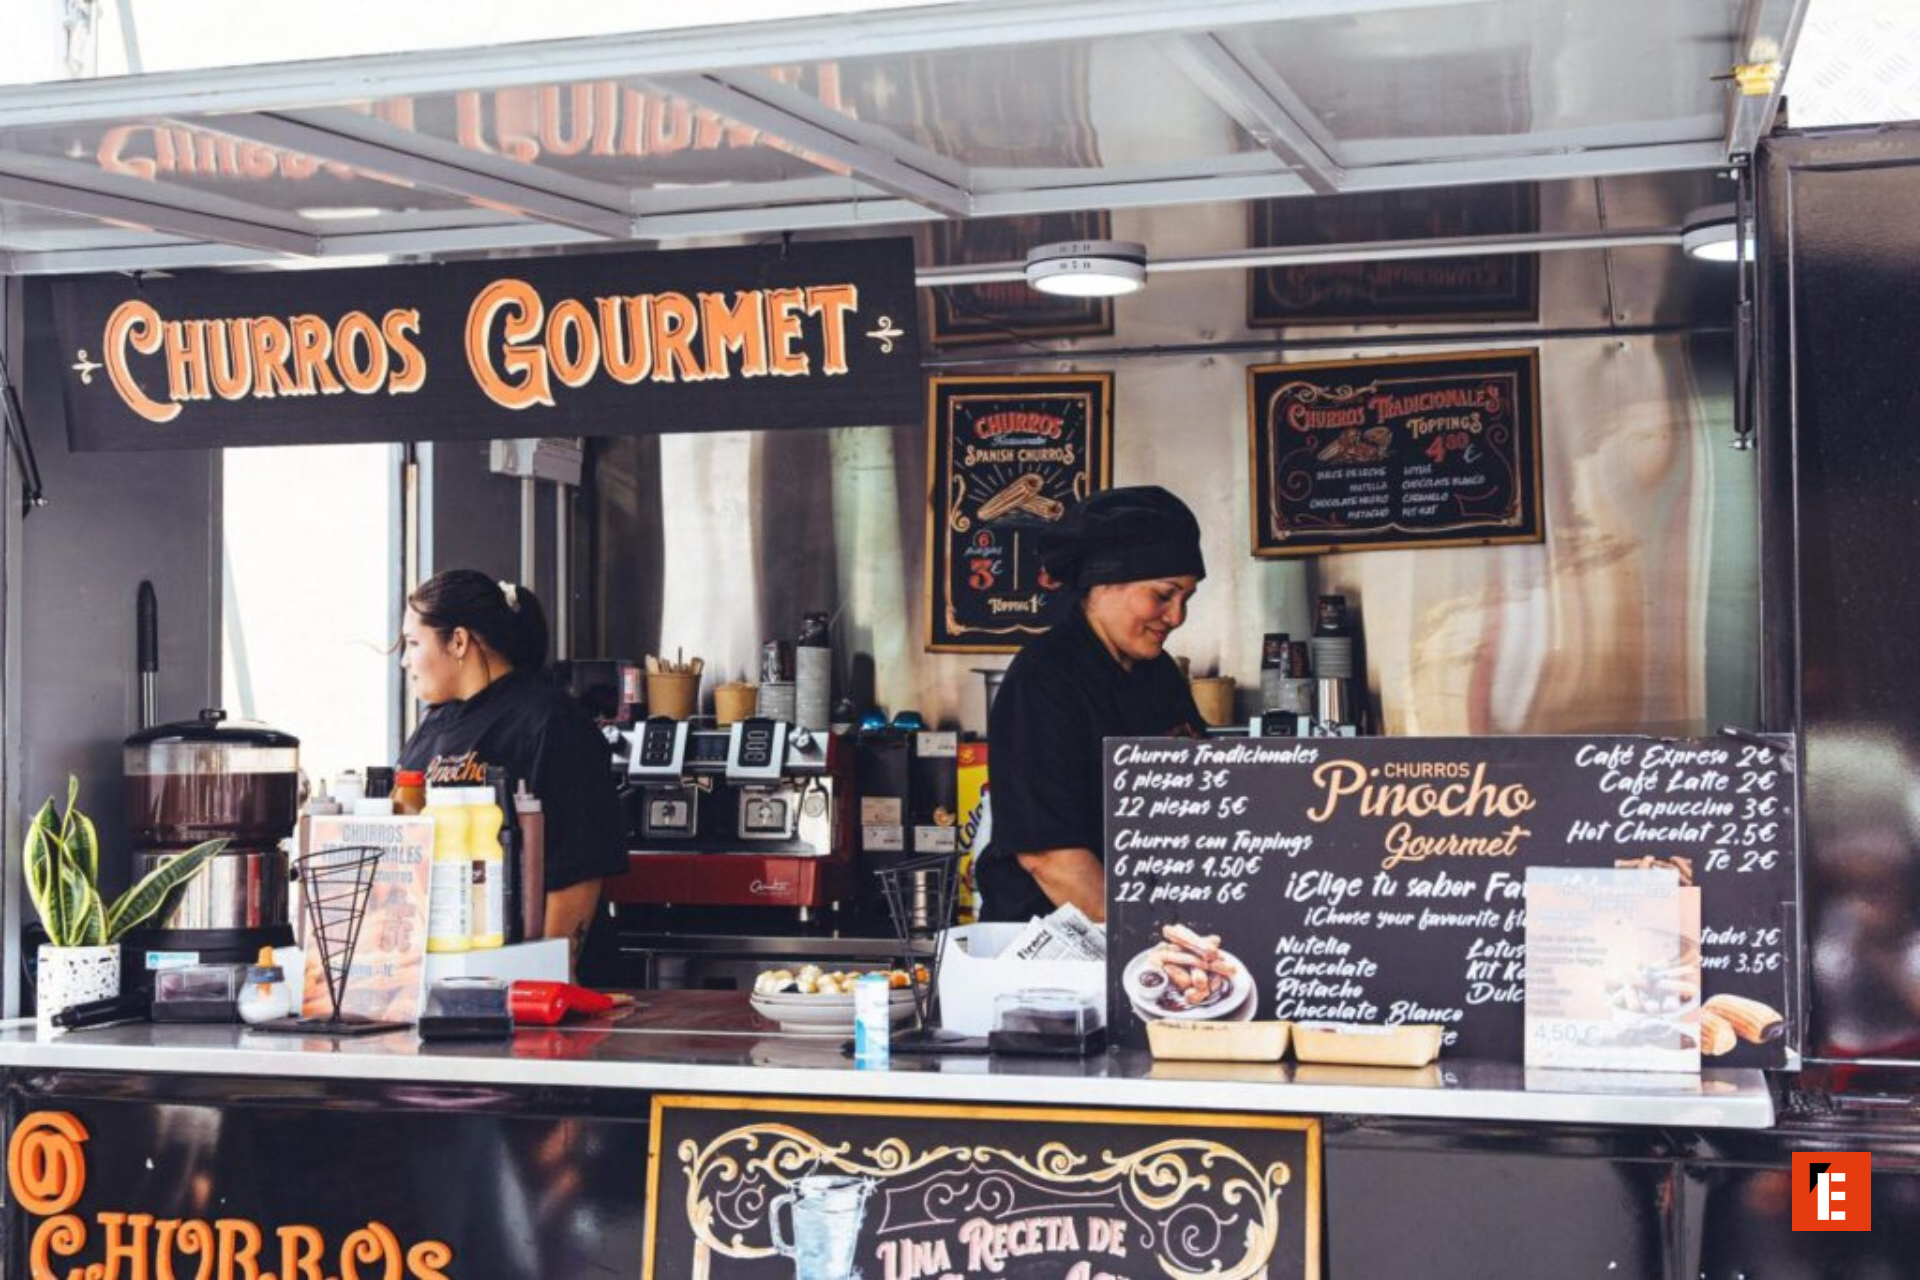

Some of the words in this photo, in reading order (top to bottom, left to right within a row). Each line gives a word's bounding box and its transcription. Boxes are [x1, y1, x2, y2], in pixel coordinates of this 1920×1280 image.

[104, 299, 426, 422] CHURROS
[465, 278, 859, 410] GOURMET
[1287, 402, 1366, 431] CHURROS
[1369, 385, 1500, 423] TRADICIONALES
[975, 411, 1064, 439] CHURROS
[1406, 412, 1483, 439] TOPPINGS
[965, 445, 1014, 466] SPANISH
[1018, 443, 1075, 465] CHURROS
[1113, 744, 1190, 765] Churros
[1194, 743, 1319, 765] Tradicionales
[1575, 744, 1634, 769] Café
[1640, 744, 1728, 769] Expreso
[1735, 746, 1774, 767] 2€
[1113, 770, 1129, 791] 6
[1132, 770, 1194, 791] piezas
[1199, 769, 1230, 790] 3€
[1384, 762, 1470, 778] CHURROS
[1307, 760, 1536, 822] Pinocho
[1599, 770, 1658, 795] Café
[1665, 770, 1729, 794] Latte
[1735, 770, 1778, 794] 2€
[1114, 796, 1145, 817] 12
[1150, 798, 1211, 818] piezas
[1217, 796, 1248, 818] 5€
[1618, 796, 1734, 819] Capuccino
[1741, 797, 1779, 820] 3€
[342, 824, 404, 843] CHURROS
[1114, 830, 1190, 850] Churros
[1195, 836, 1227, 849] con
[1232, 830, 1313, 857] Toppings
[1566, 820, 1611, 843] Hot
[1614, 820, 1714, 843] Chocolat
[1715, 822, 1778, 845] 2.5€
[1381, 822, 1532, 870] Gourmet
[1114, 855, 1129, 876] 6
[1132, 857, 1195, 876] piezas
[1202, 856, 1262, 877] 4.50€
[1704, 848, 1731, 872] Te
[1737, 850, 1779, 873] 2€
[1114, 882, 1145, 902] 12
[1150, 883, 1211, 903] piezas
[1217, 882, 1248, 904] 6€
[1372, 871, 1397, 897] tu
[1406, 871, 1476, 897] sabor
[1376, 912, 1414, 930] your
[1418, 907, 1500, 930] favourite
[1275, 935, 1351, 955] Nutella
[1465, 937, 1526, 960] Lotus
[1751, 928, 1781, 947] 1€
[1275, 956, 1378, 977] Chocolate
[1465, 961, 1500, 981] Kit
[1503, 961, 1526, 980] Ka
[1735, 952, 1781, 973] 3.5€
[1275, 978, 1364, 1001] Pistacho
[1465, 982, 1525, 1004] Dulc
[1275, 1000, 1378, 1020] Chocolate
[1385, 1001, 1464, 1027] Blanco
[876, 1237, 951, 1280] UNA
[958, 1217, 1080, 1272] RECETA
[1088, 1216, 1128, 1258] DE
